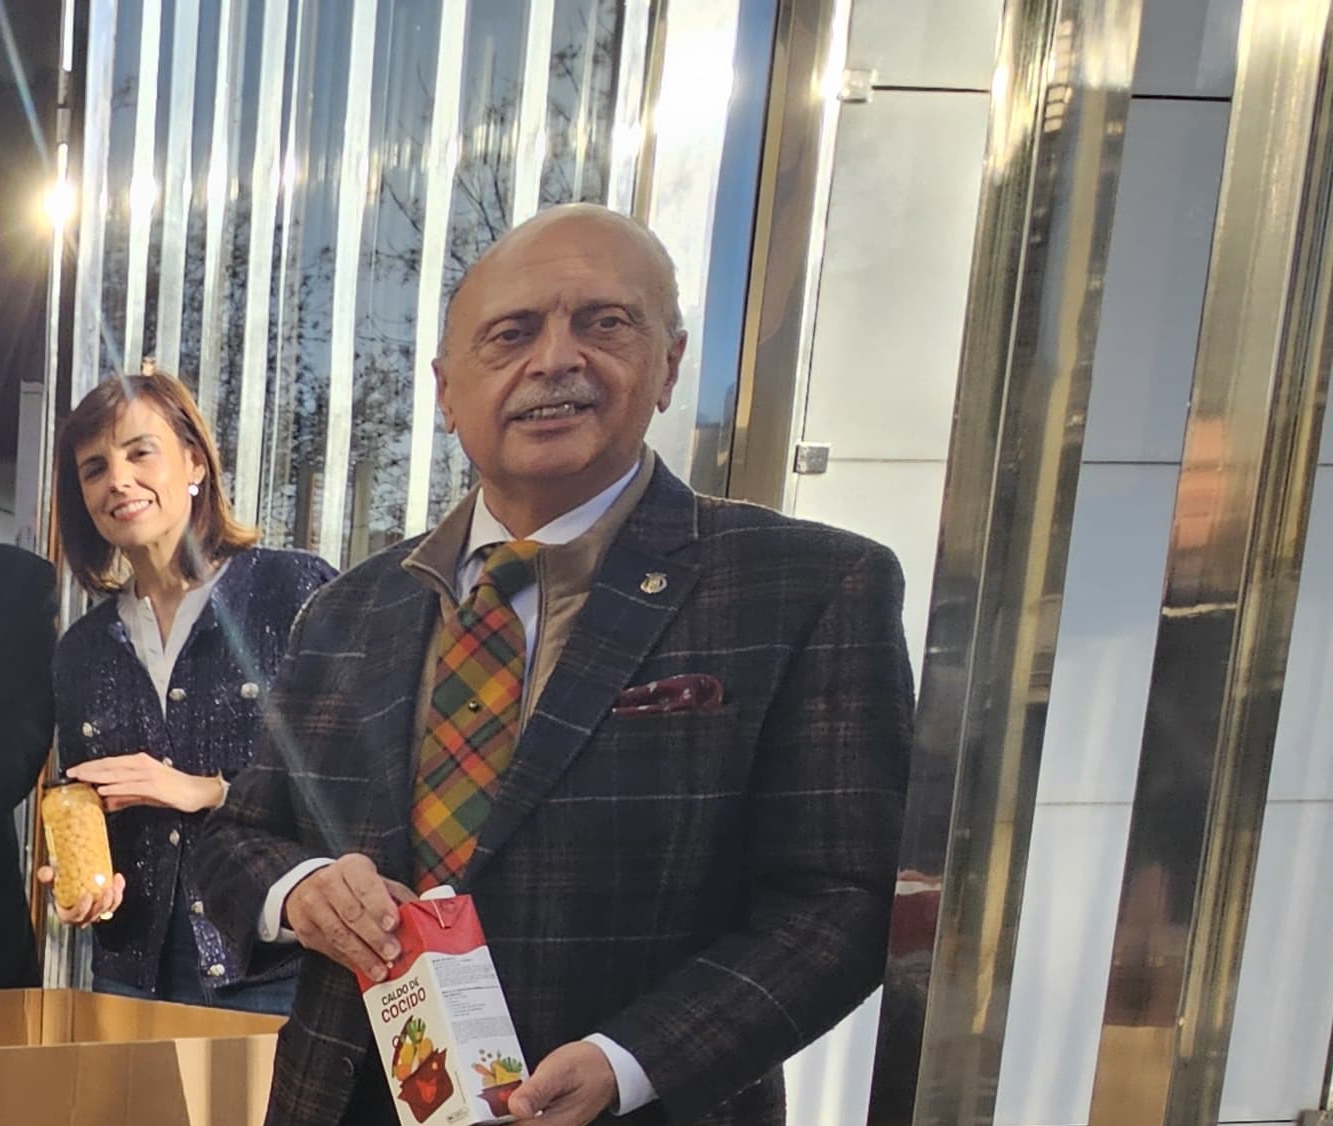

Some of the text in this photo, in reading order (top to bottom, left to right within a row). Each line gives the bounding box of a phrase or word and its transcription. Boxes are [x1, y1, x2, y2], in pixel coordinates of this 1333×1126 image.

[381, 976, 420, 1006] CALDO DE
[381, 986, 427, 1023] COCIDO
